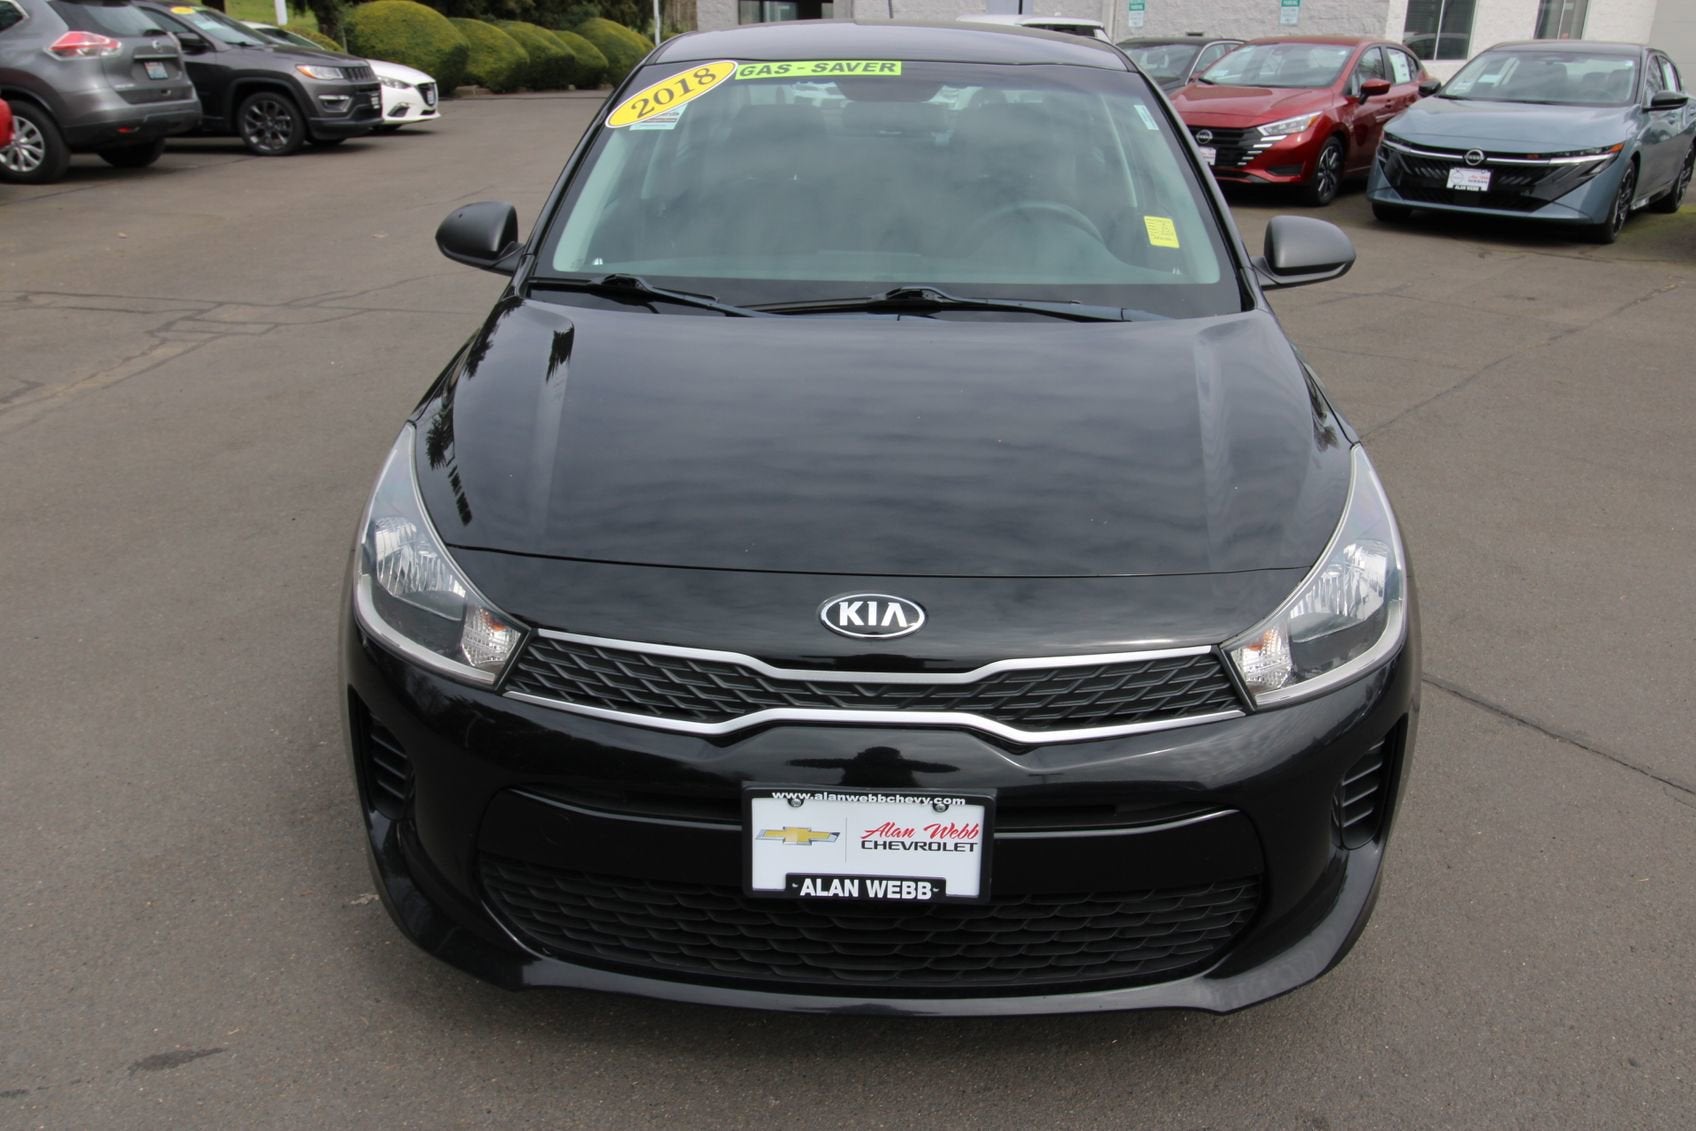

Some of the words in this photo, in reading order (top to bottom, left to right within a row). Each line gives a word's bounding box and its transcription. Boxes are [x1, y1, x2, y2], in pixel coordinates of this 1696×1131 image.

[739, 62, 791, 77] GAS
[811, 61, 897, 74] SAVER
[631, 67, 717, 119] 2018
[839, 601, 909, 628] KIA
[771, 791, 966, 806] www.alanwebbchevy.com
[860, 822, 916, 839] Alan
[923, 822, 980, 840] Webb
[861, 840, 978, 852] CHEVROLET
[800, 878, 859, 897] ALAN
[866, 880, 932, 900] WEBB
